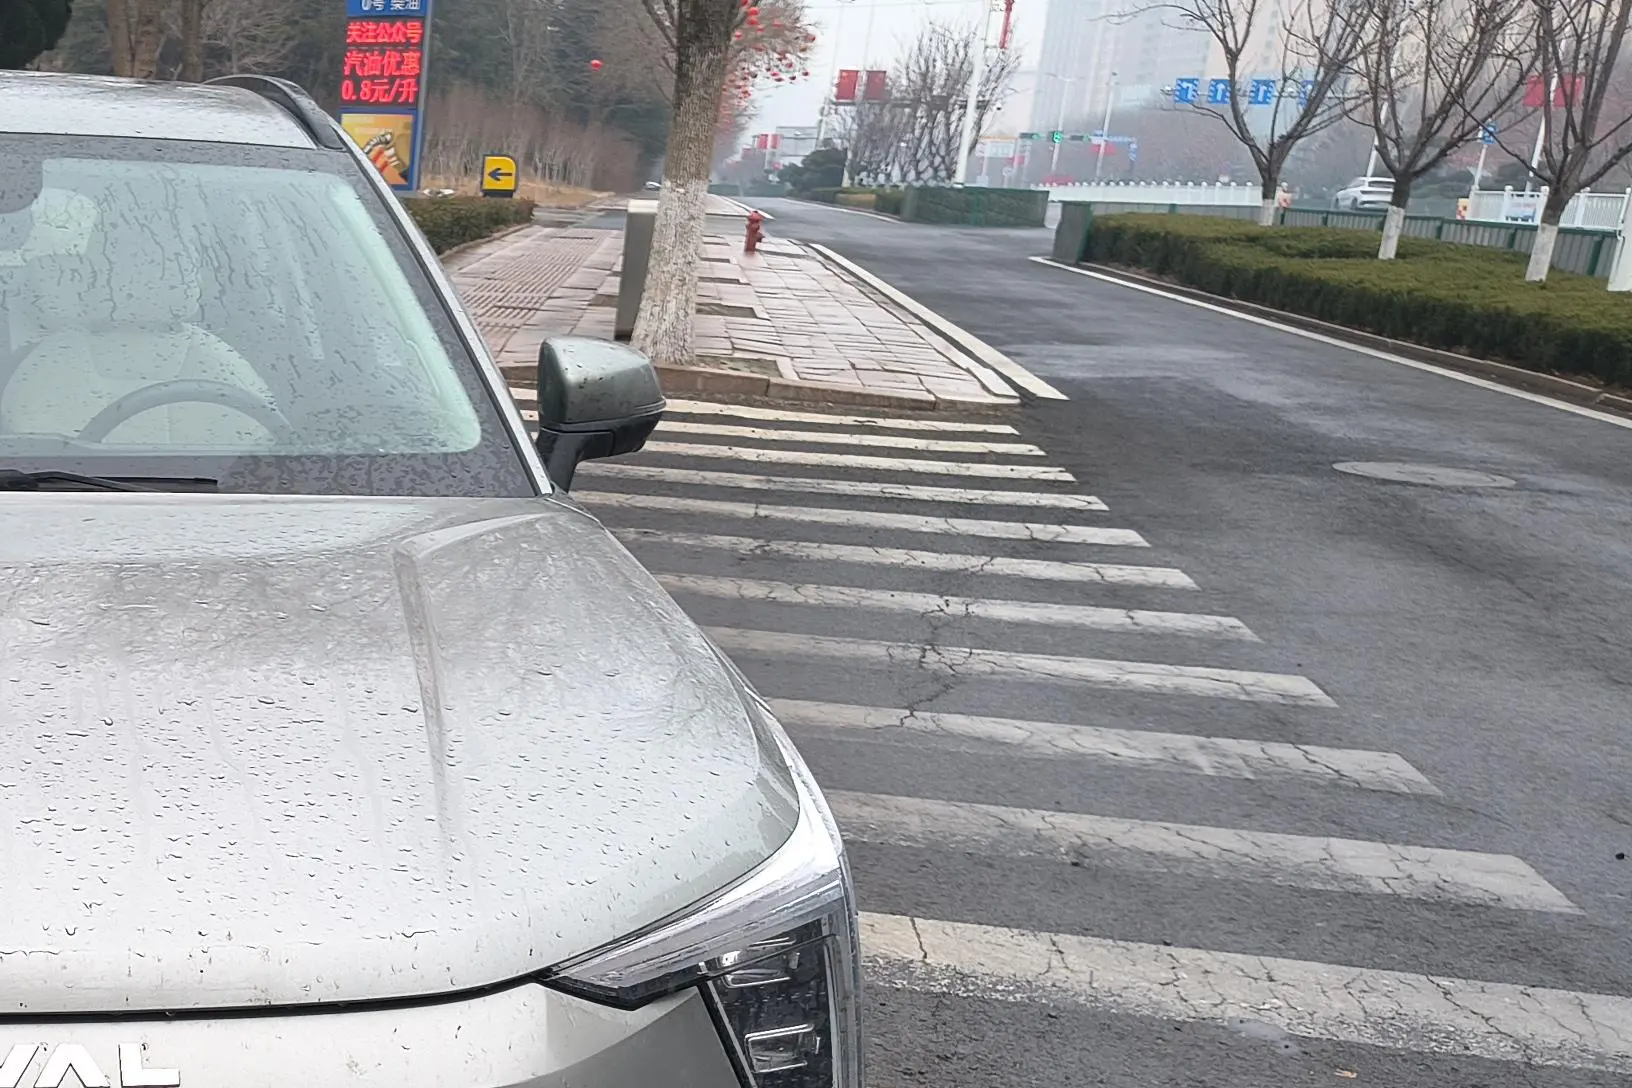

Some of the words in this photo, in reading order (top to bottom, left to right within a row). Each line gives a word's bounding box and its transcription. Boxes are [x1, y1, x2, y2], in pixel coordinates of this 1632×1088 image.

[347, 21, 423, 43] 关注公众号
[344, 50, 422, 76] 汽油优惠
[341, 78, 418, 103] 0.8元/升
